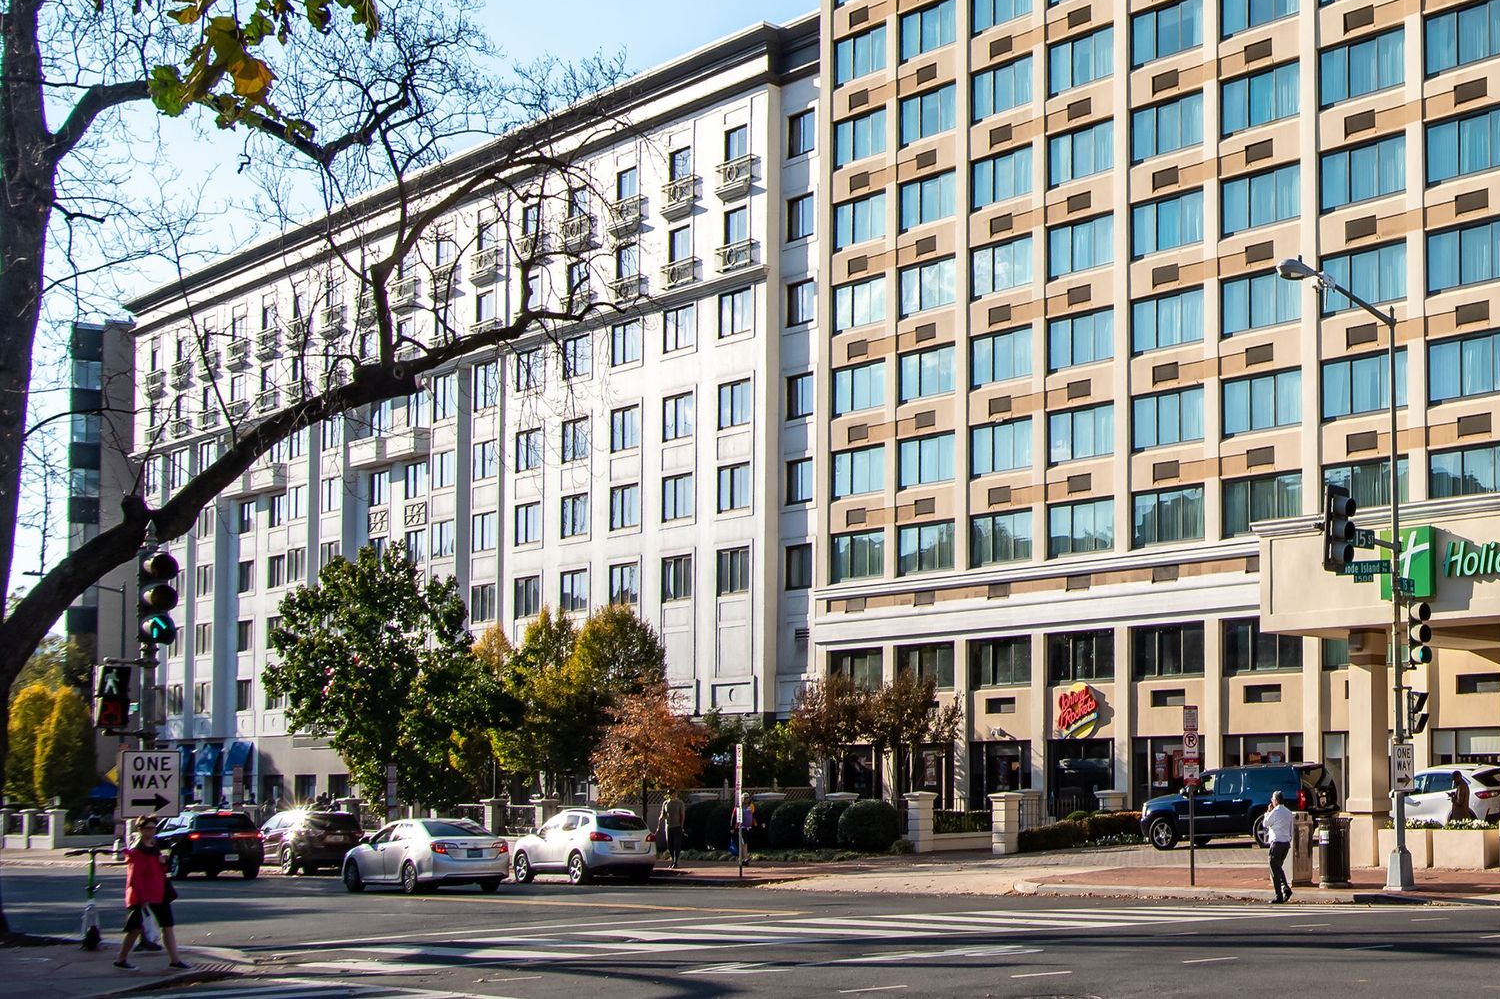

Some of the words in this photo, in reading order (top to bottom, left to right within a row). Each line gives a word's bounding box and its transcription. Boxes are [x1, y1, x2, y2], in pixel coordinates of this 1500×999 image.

[1355, 530, 1367, 547] 15
[1360, 562, 1380, 573] Island
[1396, 747, 1411, 759] ONE
[133, 756, 171, 771] ONE
[1396, 760, 1412, 771] WAY
[131, 774, 173, 789] WAY
